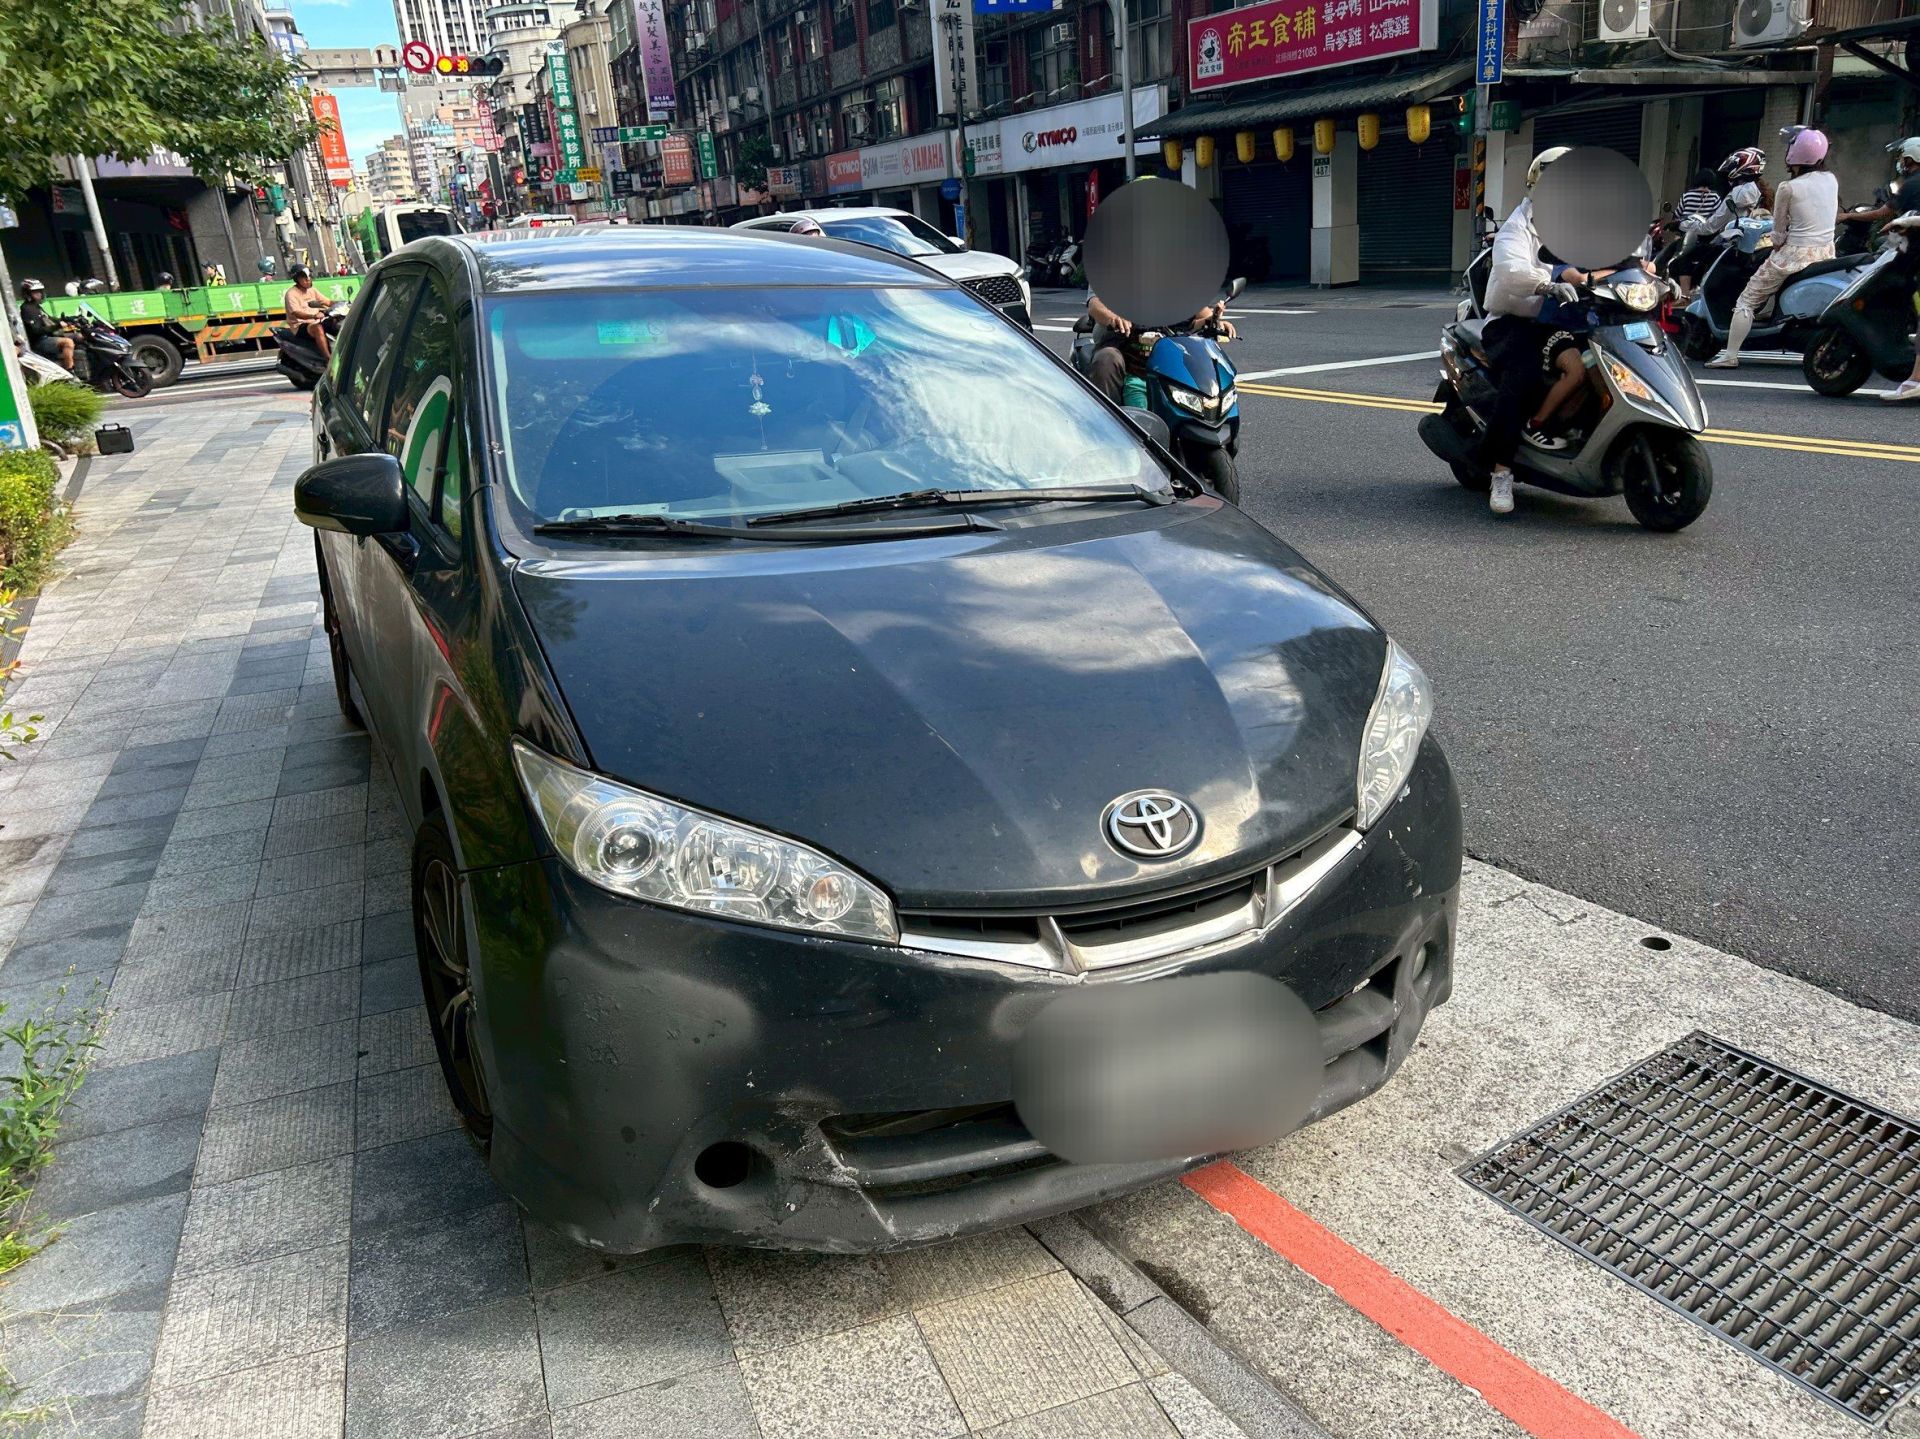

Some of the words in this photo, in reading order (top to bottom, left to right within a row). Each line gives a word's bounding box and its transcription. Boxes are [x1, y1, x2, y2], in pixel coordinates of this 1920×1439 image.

[1227, 6, 1316, 58] 帝王食補
[1368, 15, 1410, 42] 松露雞
[1037, 126, 1078, 148] KYMCO
[836, 158, 860, 176] KYMCO
[910, 142, 945, 172] YAMAHA
